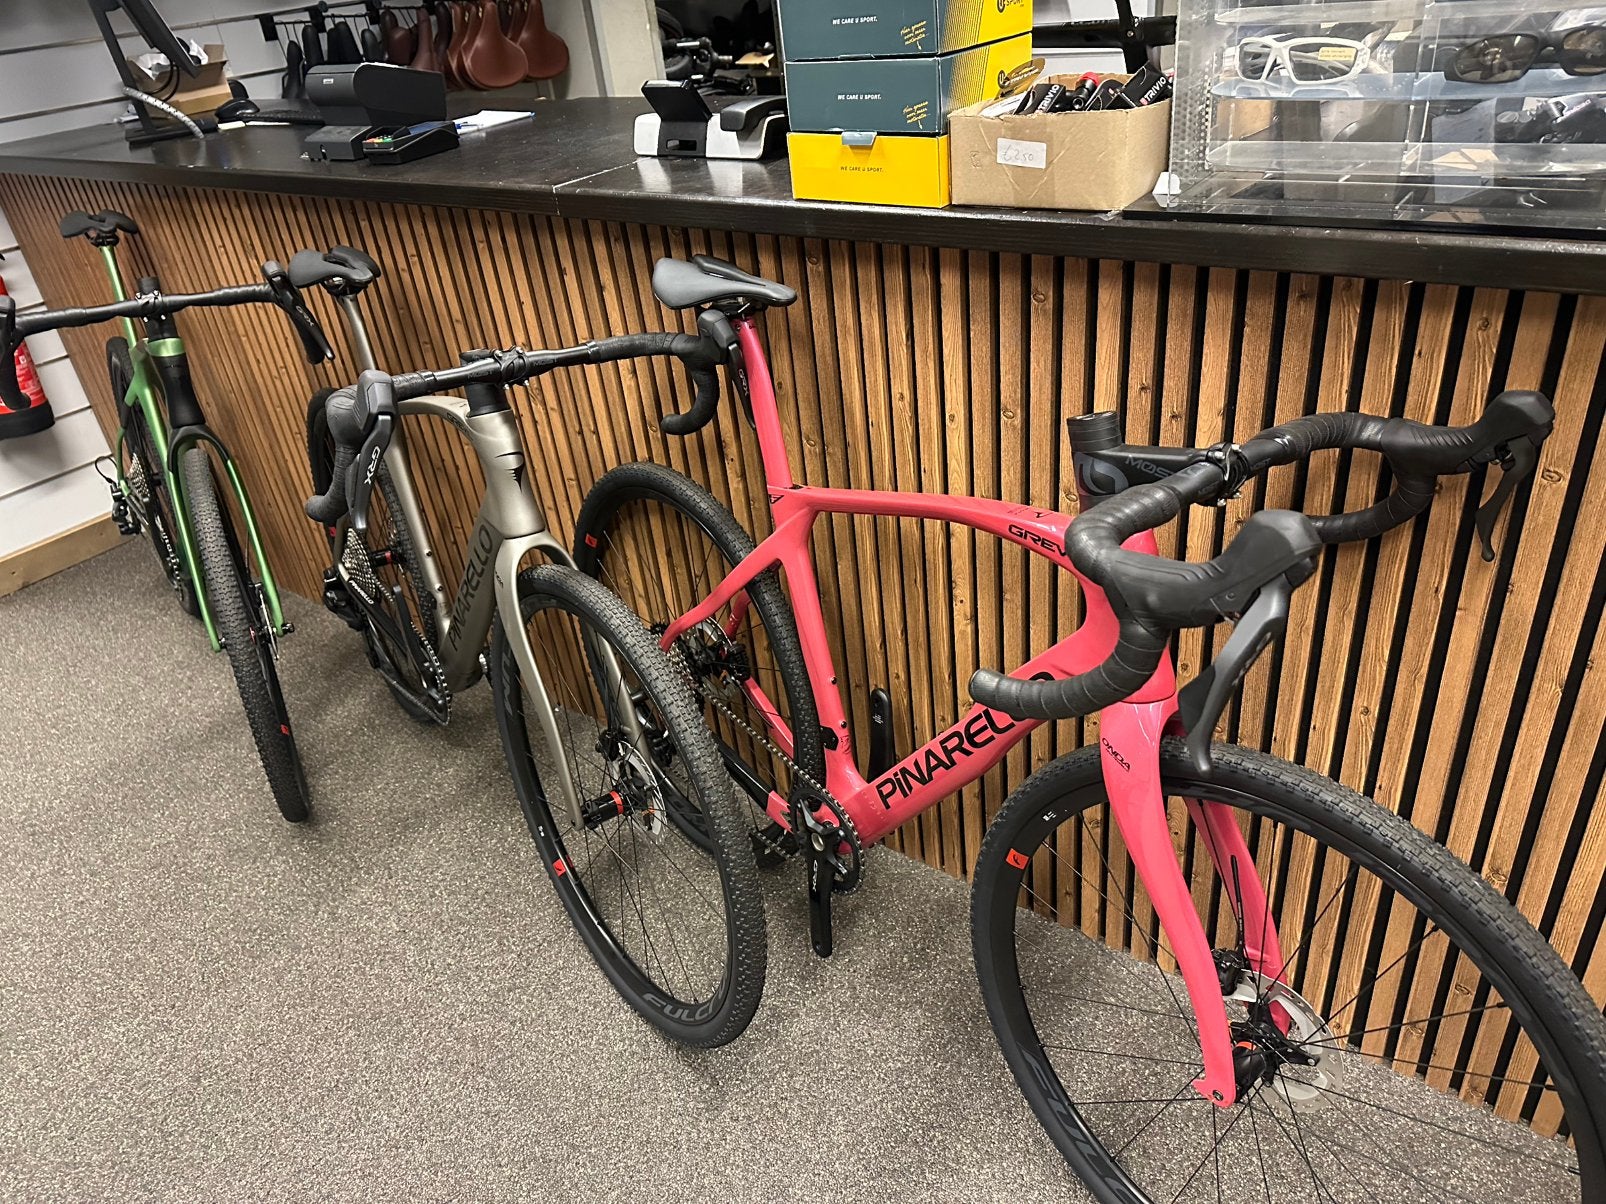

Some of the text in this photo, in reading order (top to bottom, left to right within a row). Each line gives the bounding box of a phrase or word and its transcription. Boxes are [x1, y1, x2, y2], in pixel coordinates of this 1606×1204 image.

[1144, 76, 1167, 102] TRIVIO
[364, 446, 381, 485] GRX
[1125, 455, 1177, 481] MOS
